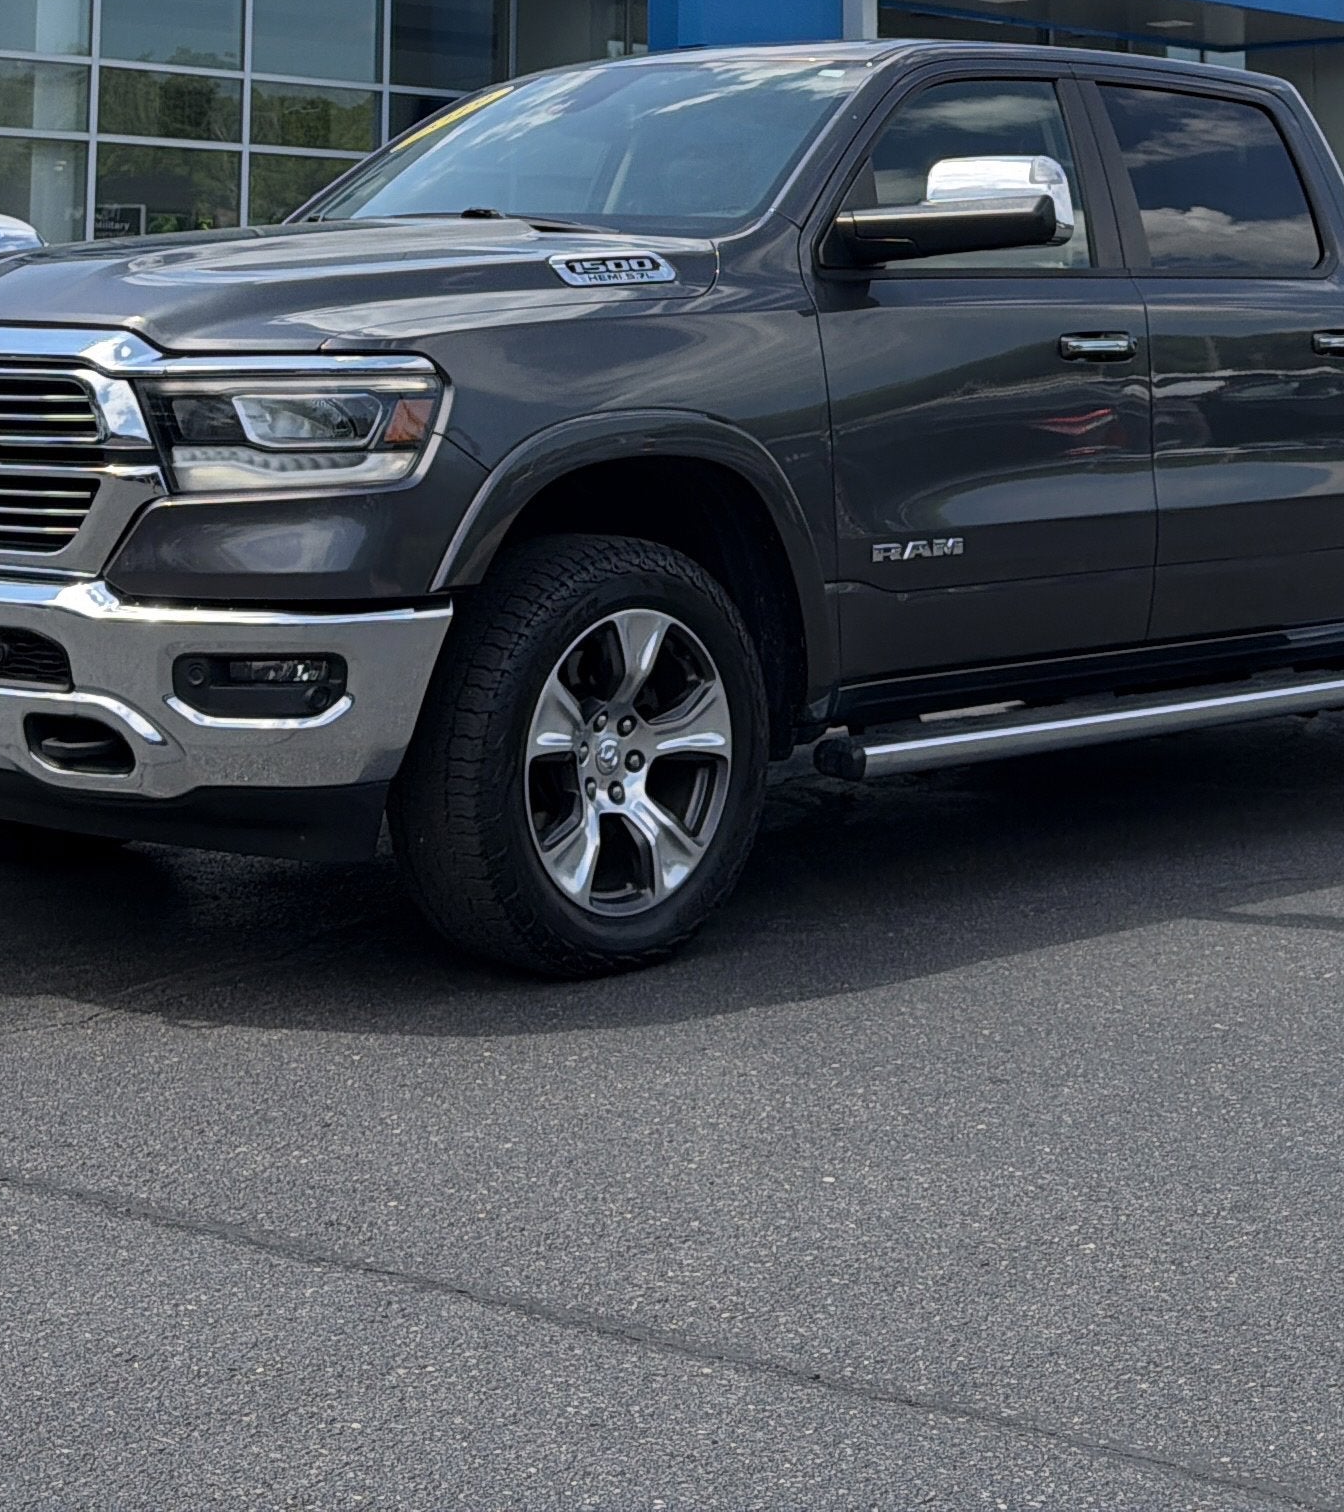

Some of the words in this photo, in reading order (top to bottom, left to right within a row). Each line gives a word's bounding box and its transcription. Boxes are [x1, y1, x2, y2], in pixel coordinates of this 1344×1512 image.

[568, 257, 653, 273] 1500
[588, 273, 624, 282] HEMI
[872, 537, 964, 563] RAM
